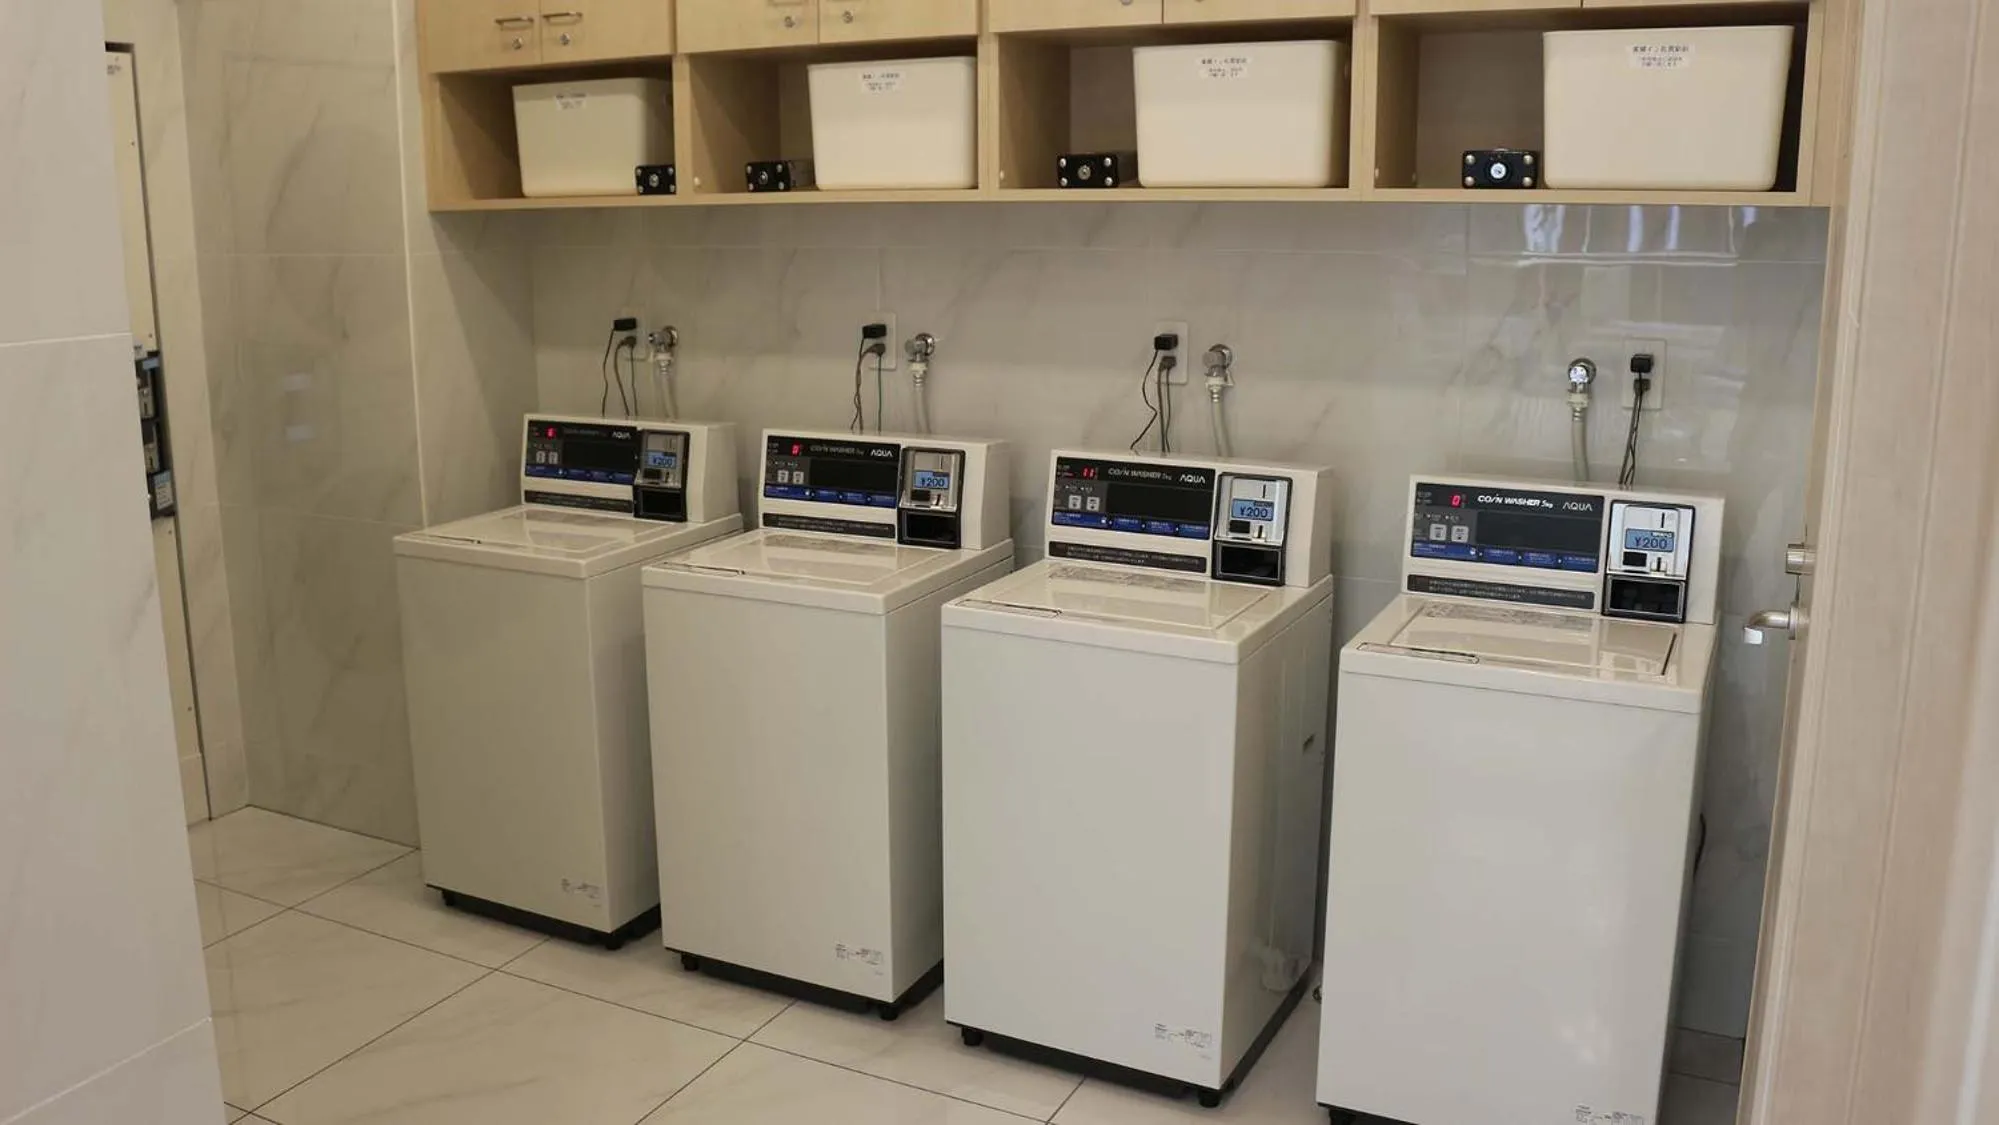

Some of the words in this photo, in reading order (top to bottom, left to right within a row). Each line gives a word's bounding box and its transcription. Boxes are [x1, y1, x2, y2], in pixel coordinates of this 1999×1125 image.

[612, 431, 631, 440] AQUA
[870, 449, 893, 457] AQUA
[1180, 474, 1205, 484] AQUA
[1451, 494, 1461, 506] 0
[1504, 497, 1541, 507] WASHER
[1562, 501, 1593, 511] AQUA
[1240, 506, 1268, 518] ¥200
[1635, 536, 1668, 550] ¥200
